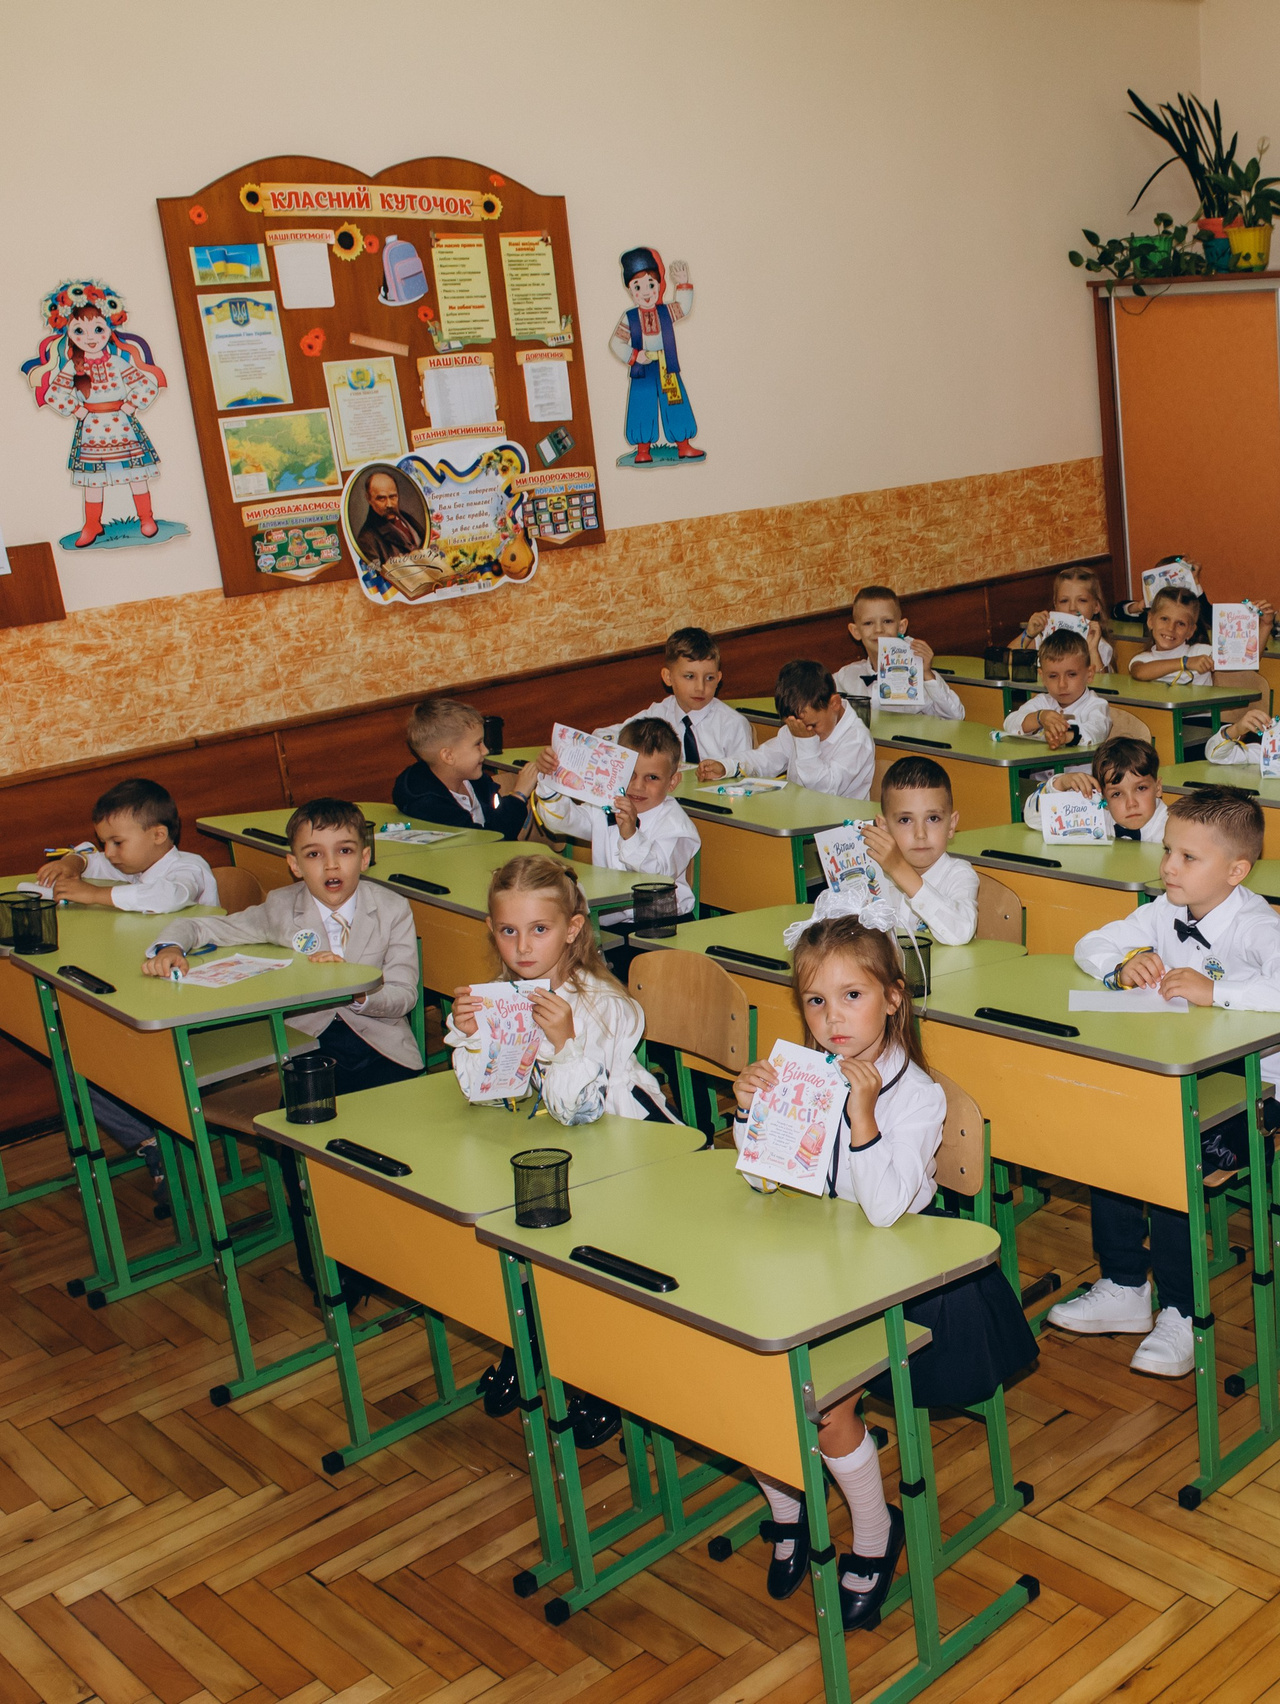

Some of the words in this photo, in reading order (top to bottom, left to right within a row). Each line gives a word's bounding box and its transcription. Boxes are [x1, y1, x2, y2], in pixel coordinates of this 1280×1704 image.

[270, 187, 371, 210] КЛАСНИЙ
[379, 192, 473, 216] КУТОЧОК
[268, 233, 289, 241] НАШІ
[289, 232, 331, 241] ПЕРЕМОГИ
[429, 358, 451, 368] НАШ
[454, 355, 481, 365] КЛАС
[525, 351, 564, 361] ДОРУЧЕННЯ
[413, 430, 446, 442] ВІТАННЯ
[448, 425, 503, 437] ІМЕНИННИКАМ
[515, 478, 527, 486] МИ
[528, 471, 590, 484] ПОДОРОЖУЄМО
[535, 485, 565, 495] ПОРАДИ
[567, 482, 595, 491] УЧНЯМ
[246, 511, 261, 520] МИ
[262, 501, 340, 517] РОЗВАЖАЄМОСЬ
[438, 503, 452, 511] Вам
[453, 501, 464, 509] Бог
[446, 514, 453, 522] За
[455, 513, 466, 521] вас
[459, 524, 470, 532] вас
[472, 522, 489, 530] слава
[1236, 620, 1243, 631] 1
[884, 654, 891, 666] 1
[1269, 739, 1277, 753] 1
[595, 766, 611, 777] 1
[1063, 804, 1088, 816] Вітаю
[1055, 815, 1066, 830] 1
[1065, 815, 1097, 829] КЛАСІ!
[833, 842, 856, 857] Вітаю
[829, 855, 841, 874] 1
[839, 852, 867, 871] КЛАСІ!
[514, 1012, 526, 1033] 1
[500, 1029, 537, 1046] КЛАСІ!
[781, 1061, 826, 1088] Вітаю
[790, 1082, 806, 1107] 1
[768, 1093, 819, 1123] КЛАСІ!
